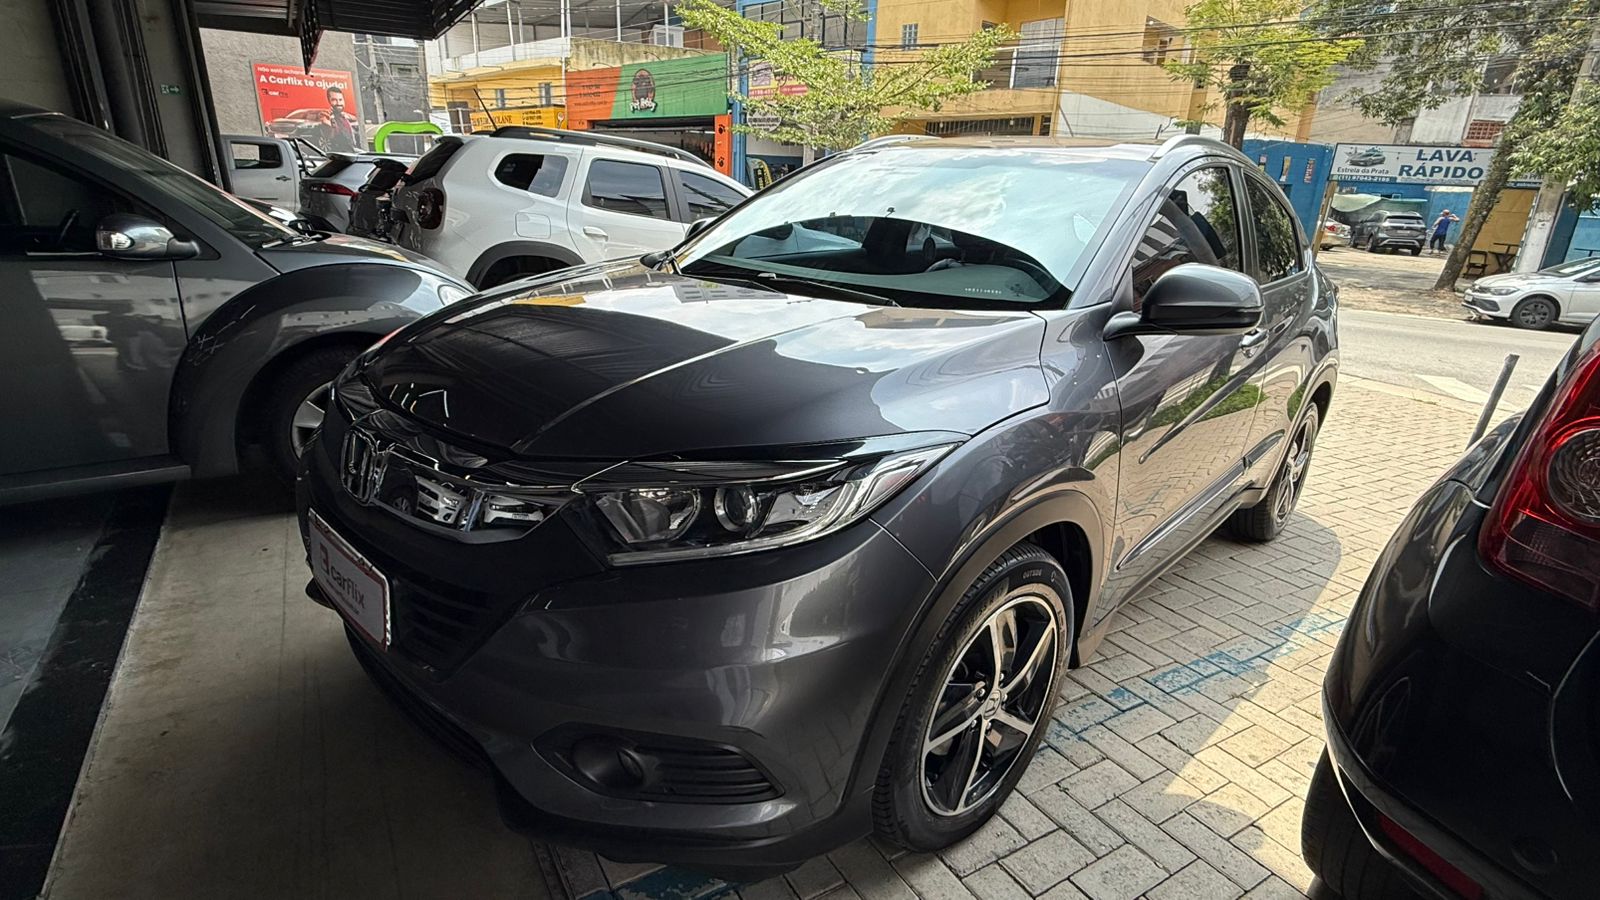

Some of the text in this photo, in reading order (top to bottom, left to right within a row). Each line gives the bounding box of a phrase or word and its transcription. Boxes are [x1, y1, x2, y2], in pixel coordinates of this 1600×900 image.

[260, 75, 348, 90] A Carflix te ajuda!
[1416, 149, 1473, 162] LAVA
[1336, 166, 1361, 174] Estrela
[1370, 167, 1389, 175] Prata
[1398, 162, 1484, 179] RÁPIDO
[331, 566, 365, 609] carflix
